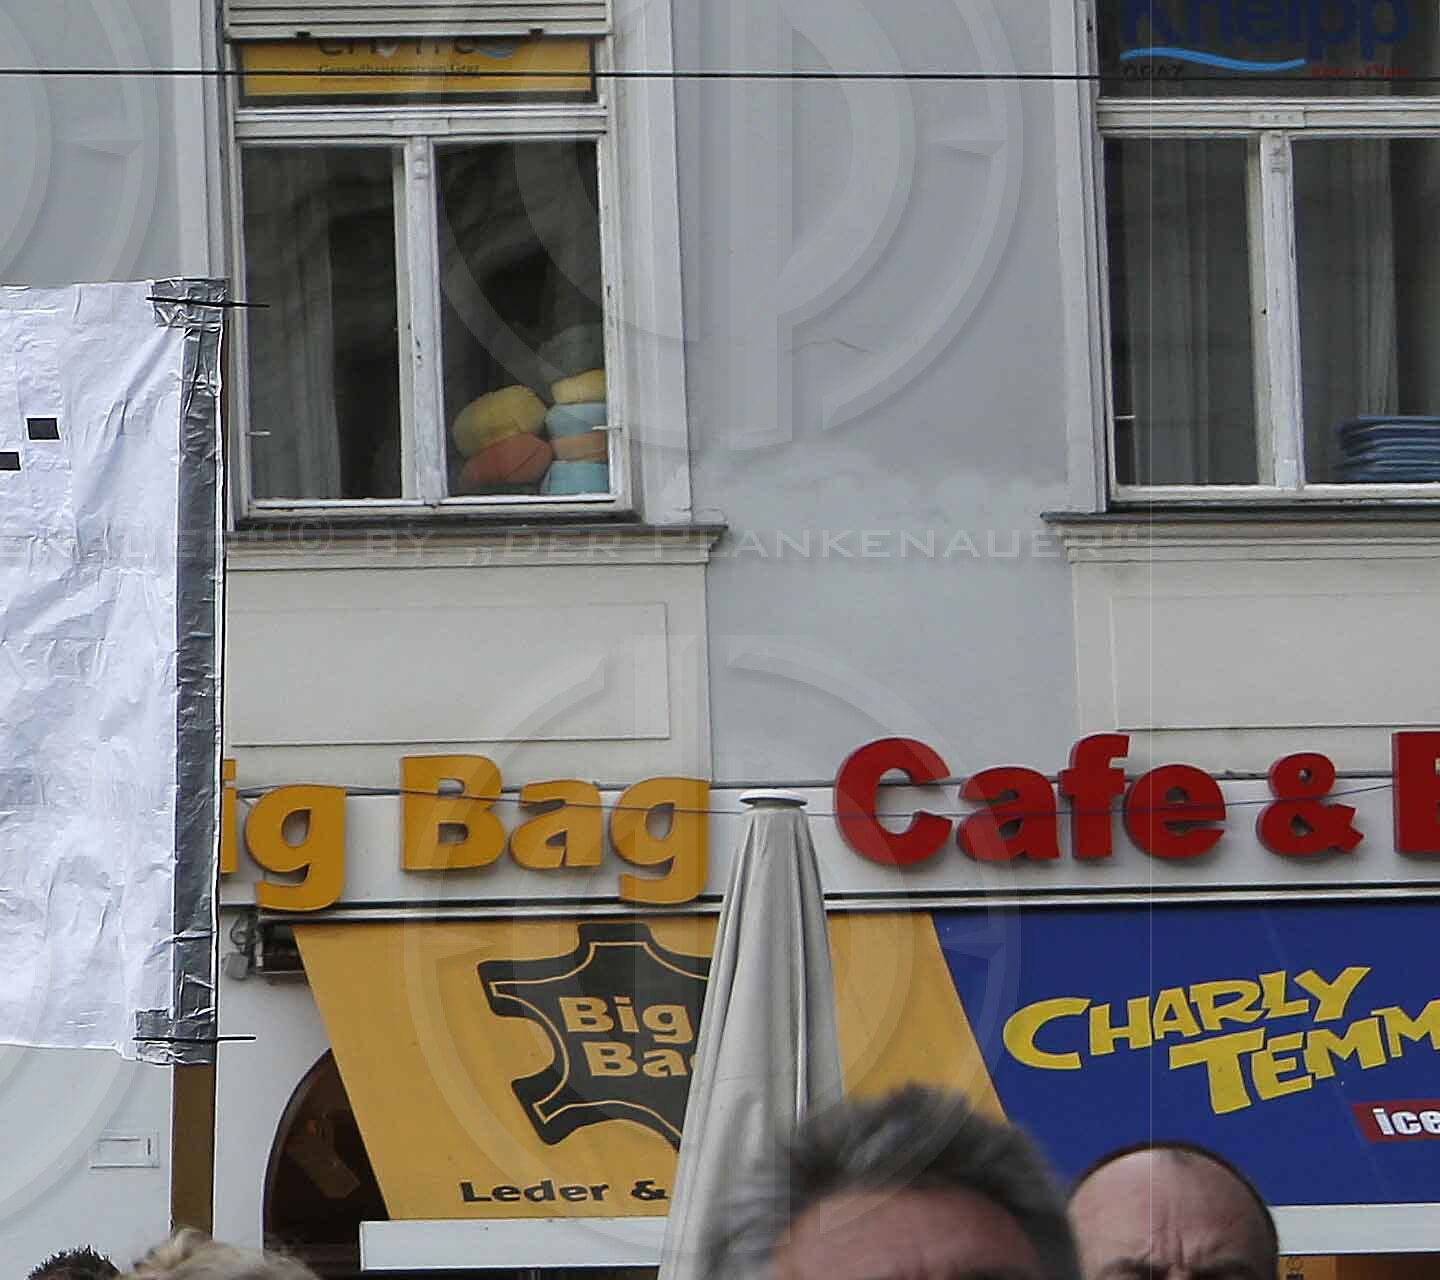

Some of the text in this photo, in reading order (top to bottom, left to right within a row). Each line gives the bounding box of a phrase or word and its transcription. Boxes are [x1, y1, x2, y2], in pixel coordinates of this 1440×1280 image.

[399, 754, 712, 905] Bag
[832, 736, 1226, 866] Cafe
[1255, 751, 1365, 859] &
[559, 994, 694, 1045] Big
[1002, 966, 1372, 1071] CHARLY
[582, 1040, 698, 1079] Ba
[459, 1178, 609, 1203] Leder
